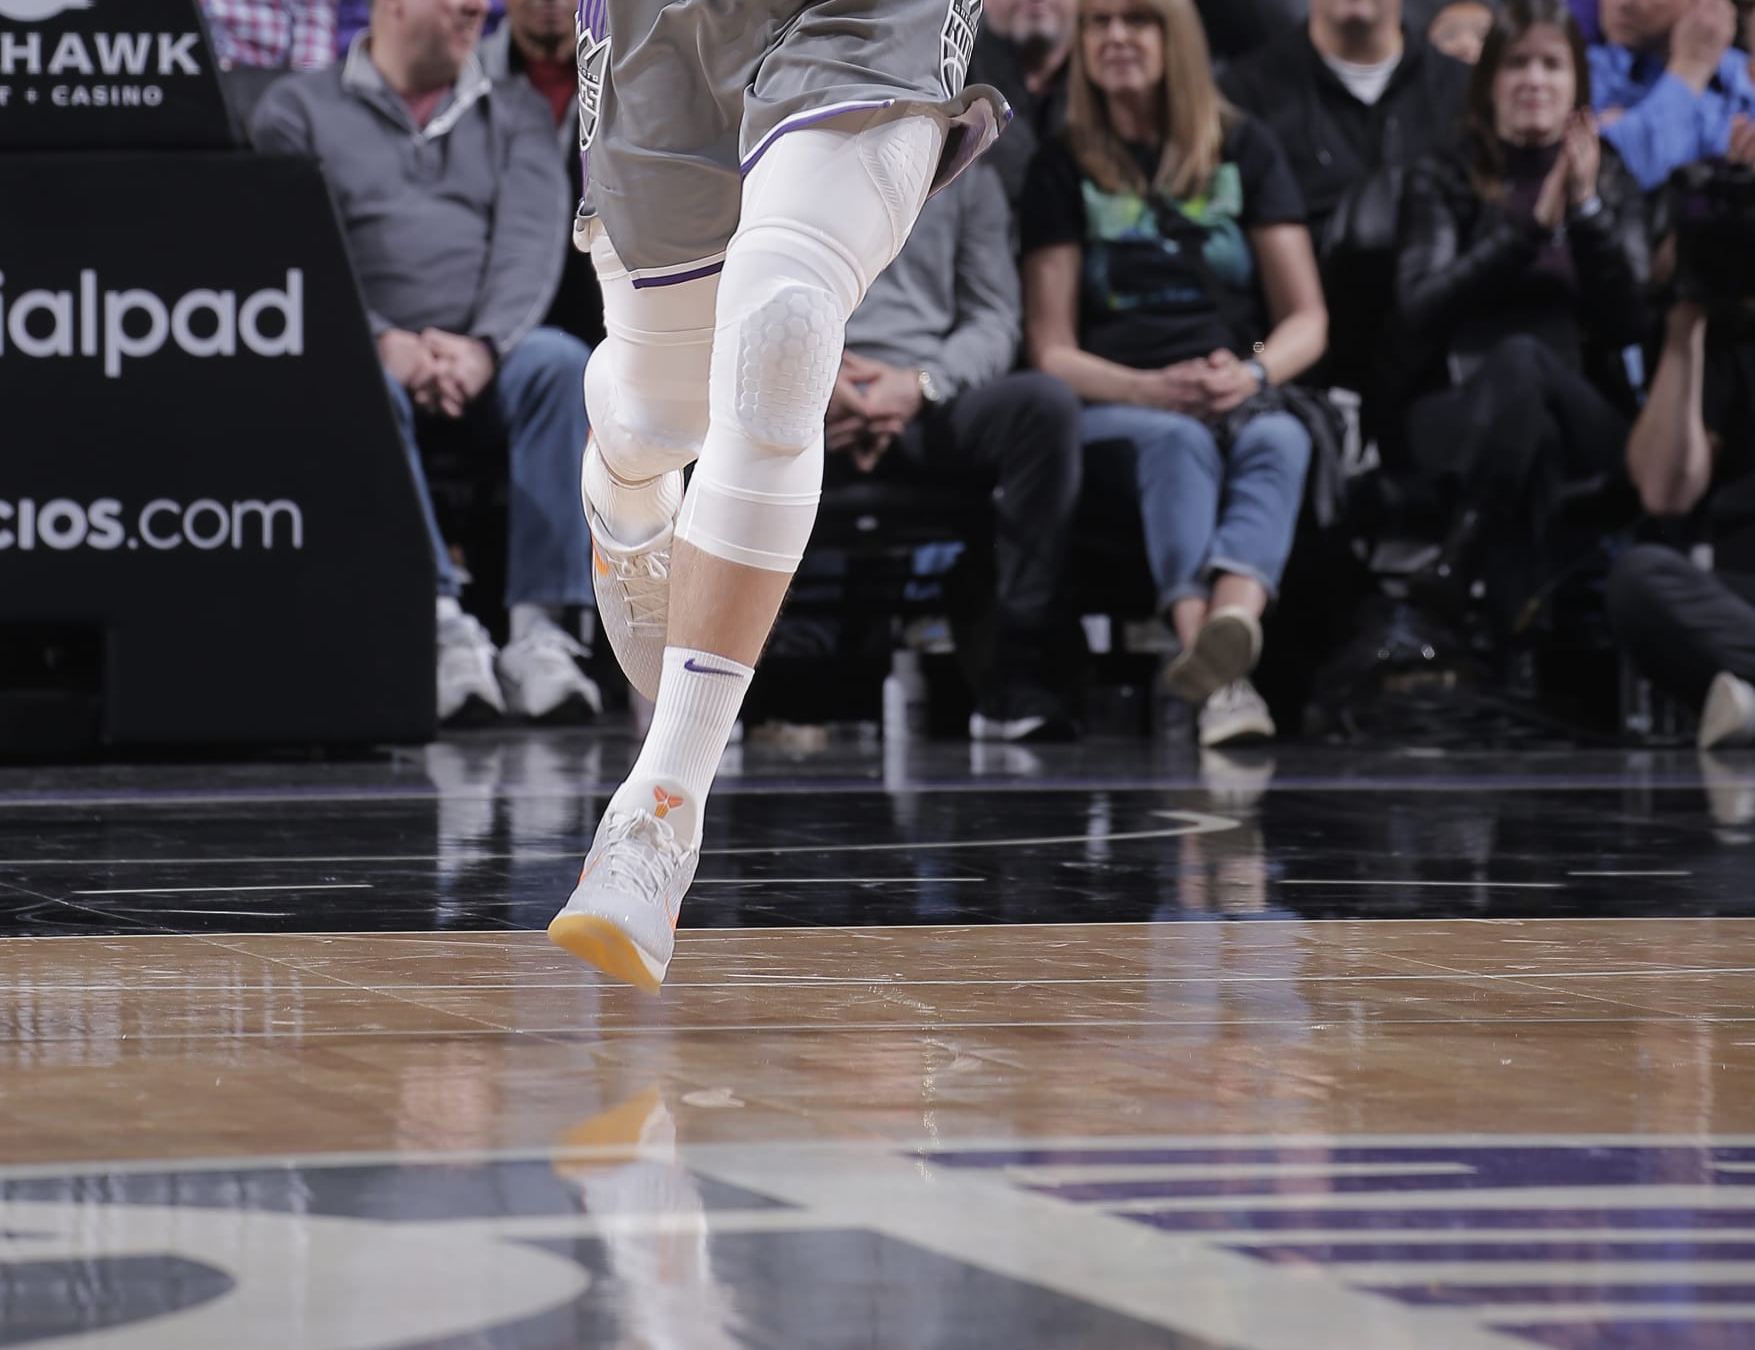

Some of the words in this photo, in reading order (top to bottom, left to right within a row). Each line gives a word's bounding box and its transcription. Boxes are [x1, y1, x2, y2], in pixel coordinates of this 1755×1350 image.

[0, 31, 202, 76] HAWK
[51, 84, 164, 108] CASINO
[0, 267, 304, 379] alpad
